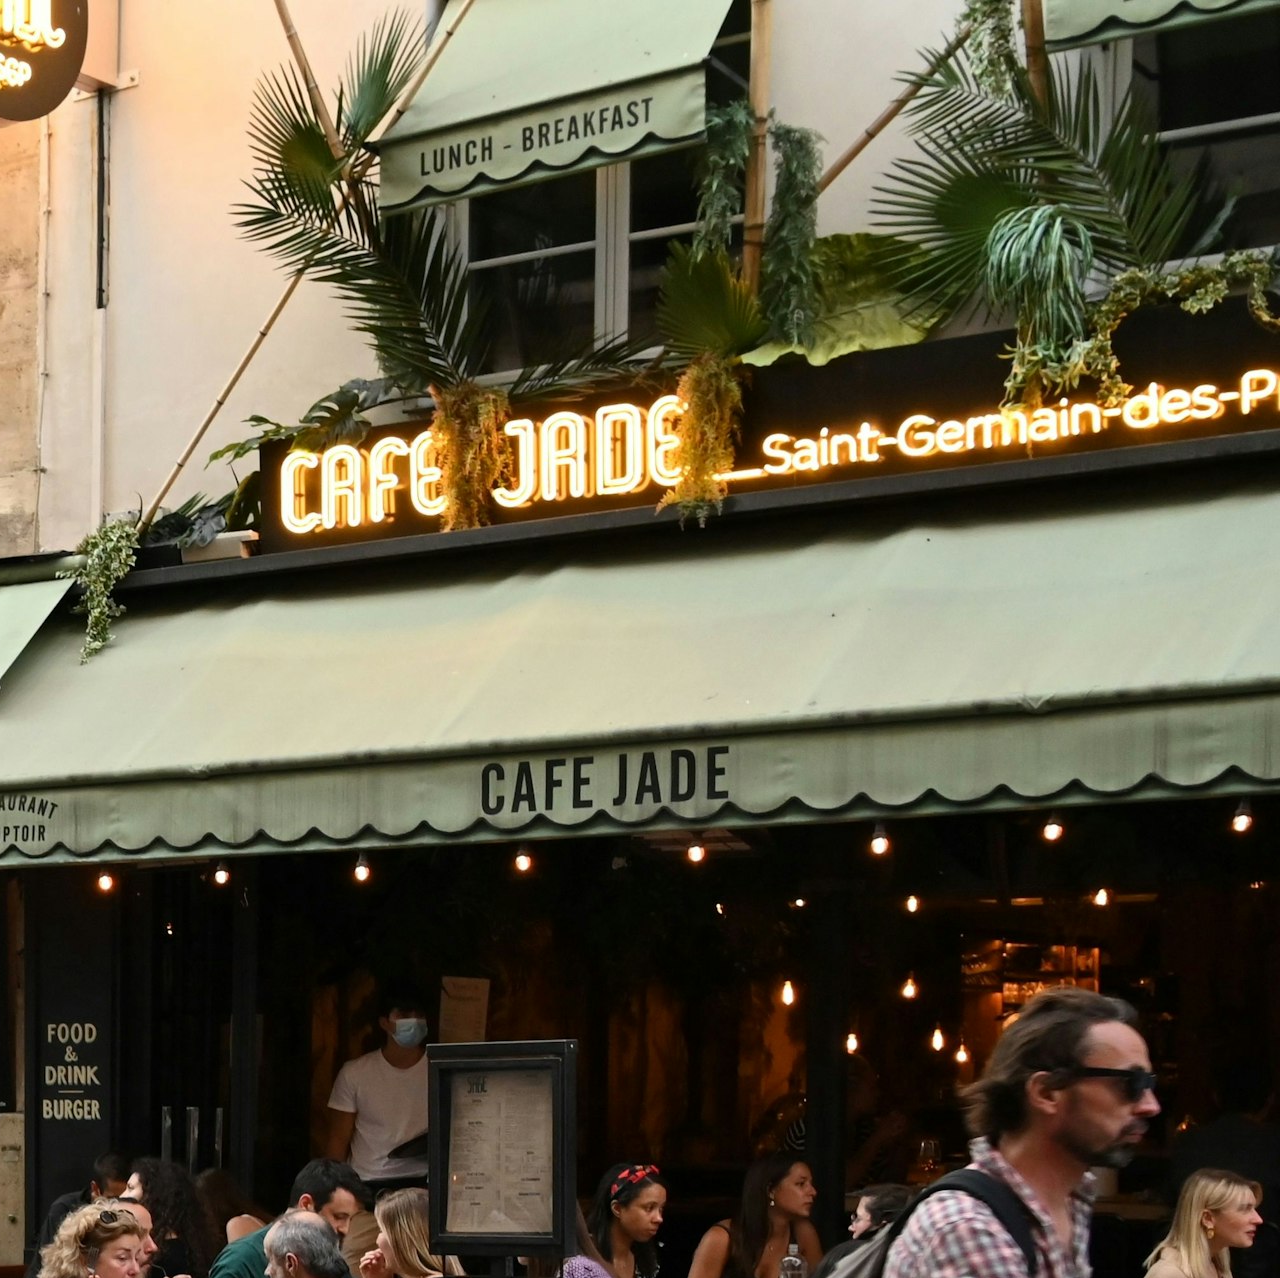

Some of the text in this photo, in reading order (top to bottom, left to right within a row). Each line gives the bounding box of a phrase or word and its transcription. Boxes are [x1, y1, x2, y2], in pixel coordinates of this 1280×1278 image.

[420, 136, 493, 177] LUNCH
[522, 97, 653, 152] BREAKFAST
[760, 368, 1280, 476] Saint-Germain-des-P
[279, 394, 689, 535] CAFE JADE
[481, 745, 729, 815] CAFE JADE
[47, 1023, 97, 1044] FOOD
[64, 1045, 79, 1062] &
[45, 1065, 101, 1086] DRINK
[42, 1098, 101, 1120] BURGER
